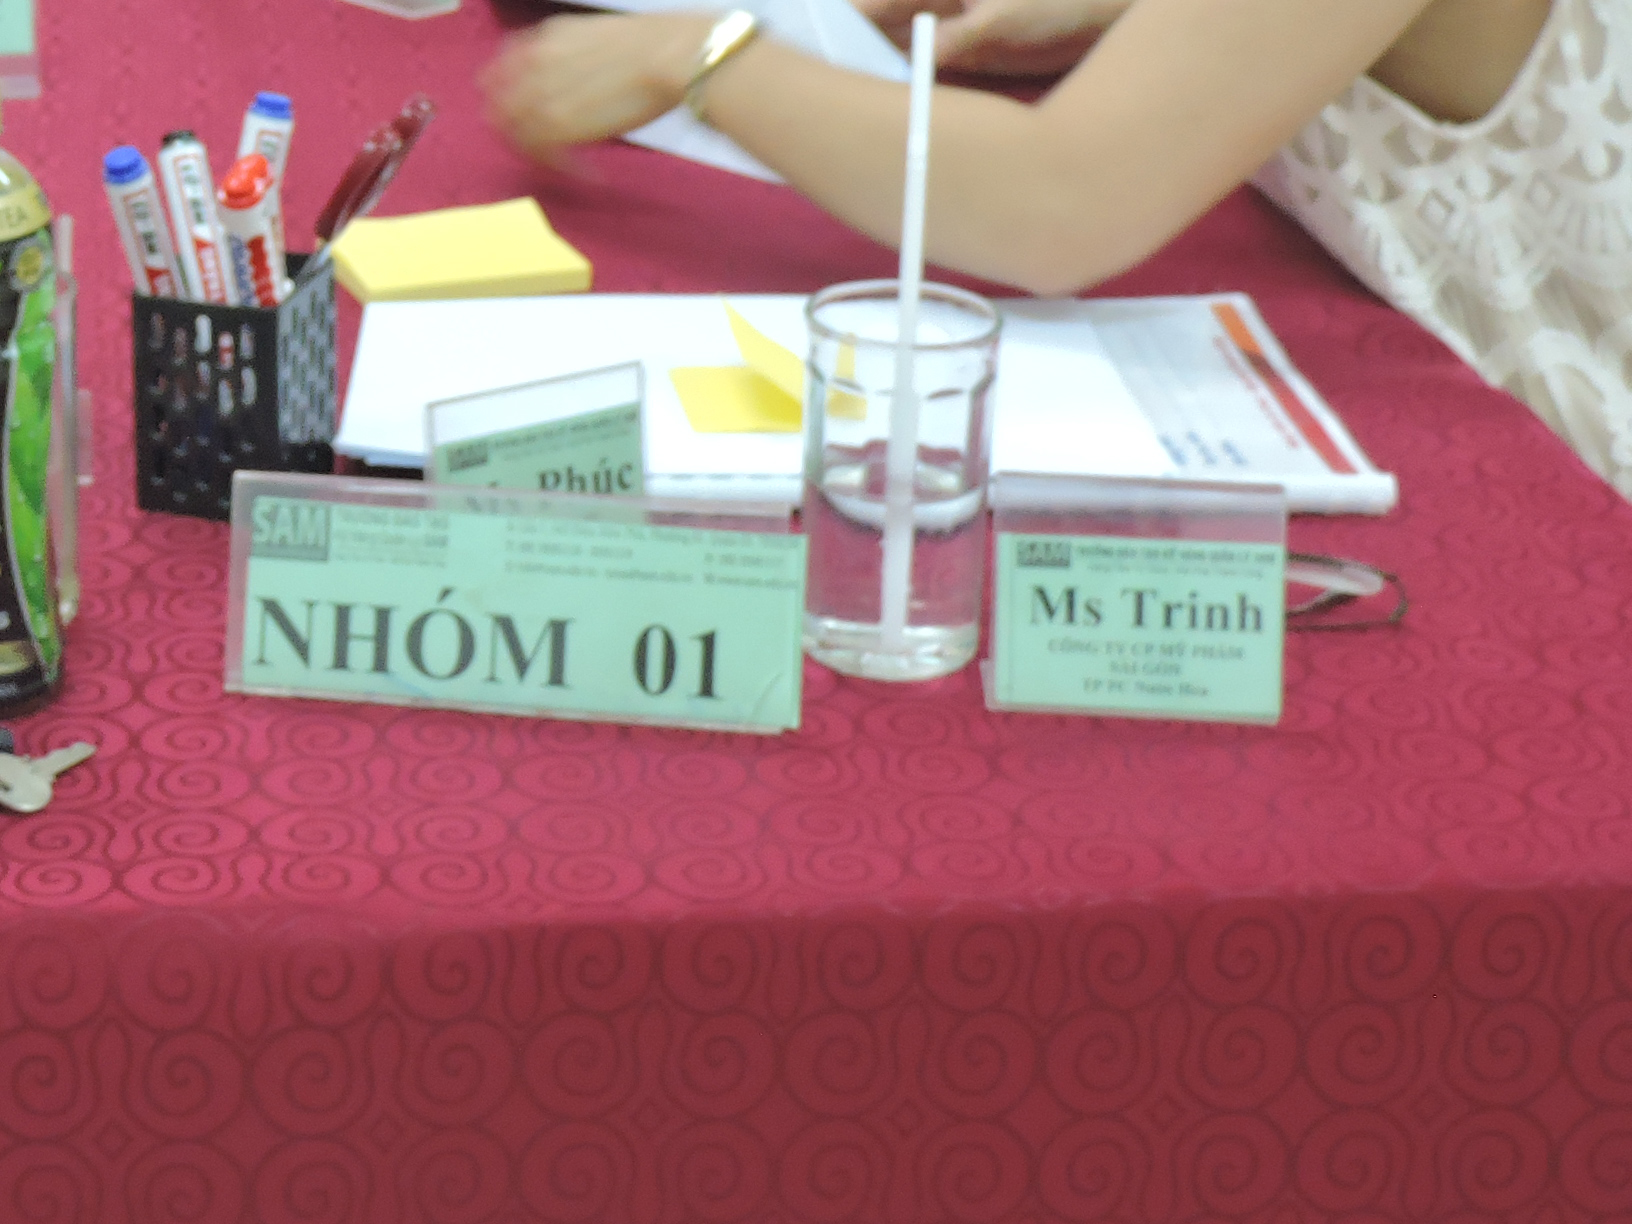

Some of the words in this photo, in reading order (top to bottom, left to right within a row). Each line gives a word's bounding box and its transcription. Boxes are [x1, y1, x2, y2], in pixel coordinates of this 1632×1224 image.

[251, 504, 326, 544] SAM
[1030, 584, 1103, 625] Ms
[1120, 587, 1263, 633] Trinh
[253, 586, 575, 688] NHÓM
[632, 623, 722, 700] 01
